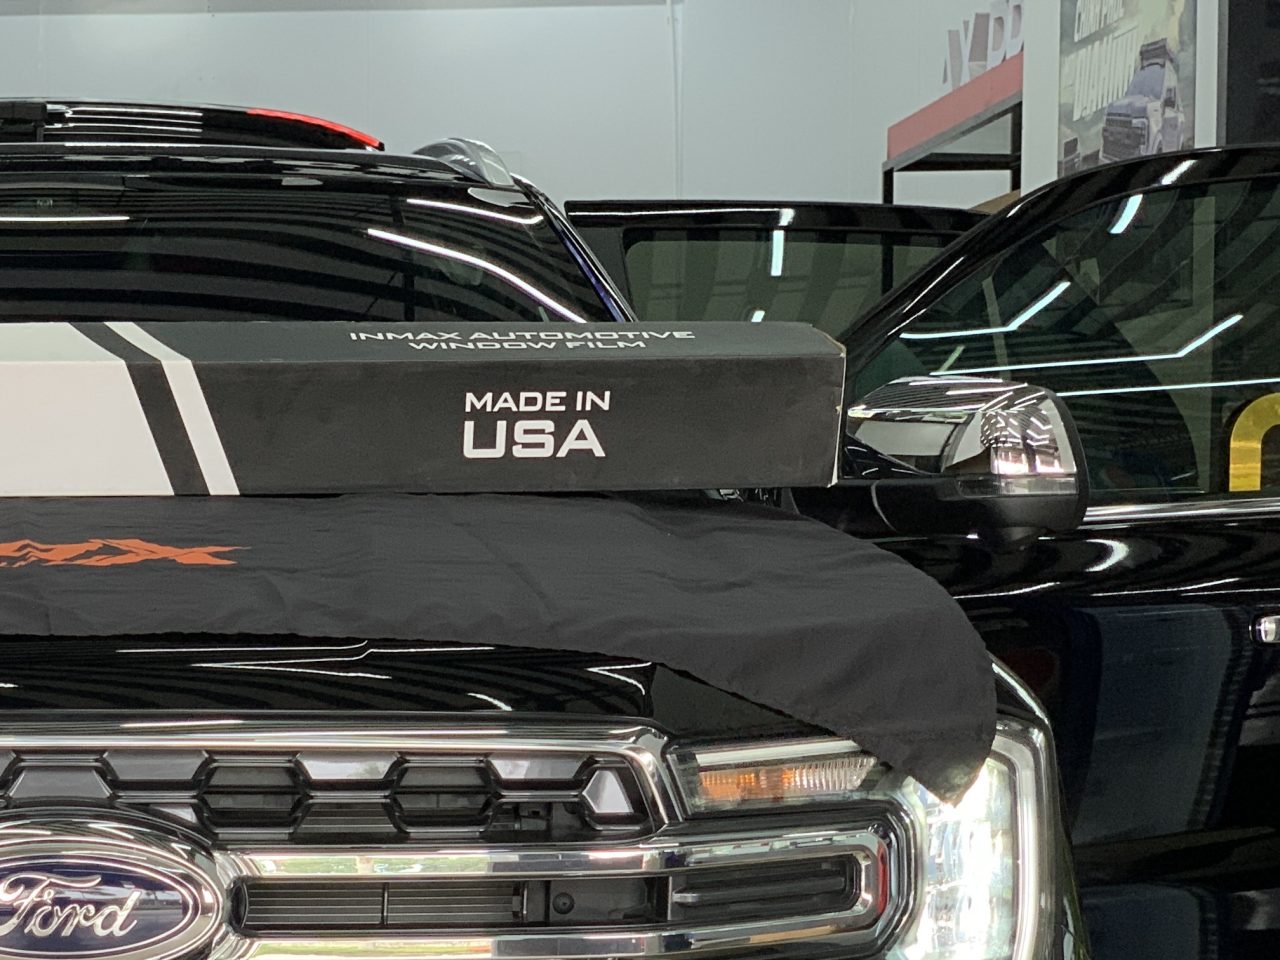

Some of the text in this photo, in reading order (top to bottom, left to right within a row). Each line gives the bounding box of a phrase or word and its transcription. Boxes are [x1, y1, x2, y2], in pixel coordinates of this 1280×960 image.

[349, 330, 696, 341] INMAX AUTOMOTIVE
[408, 340, 647, 350] WINDOW FILM
[464, 390, 611, 412] MADE IN
[462, 419, 606, 459] USA
